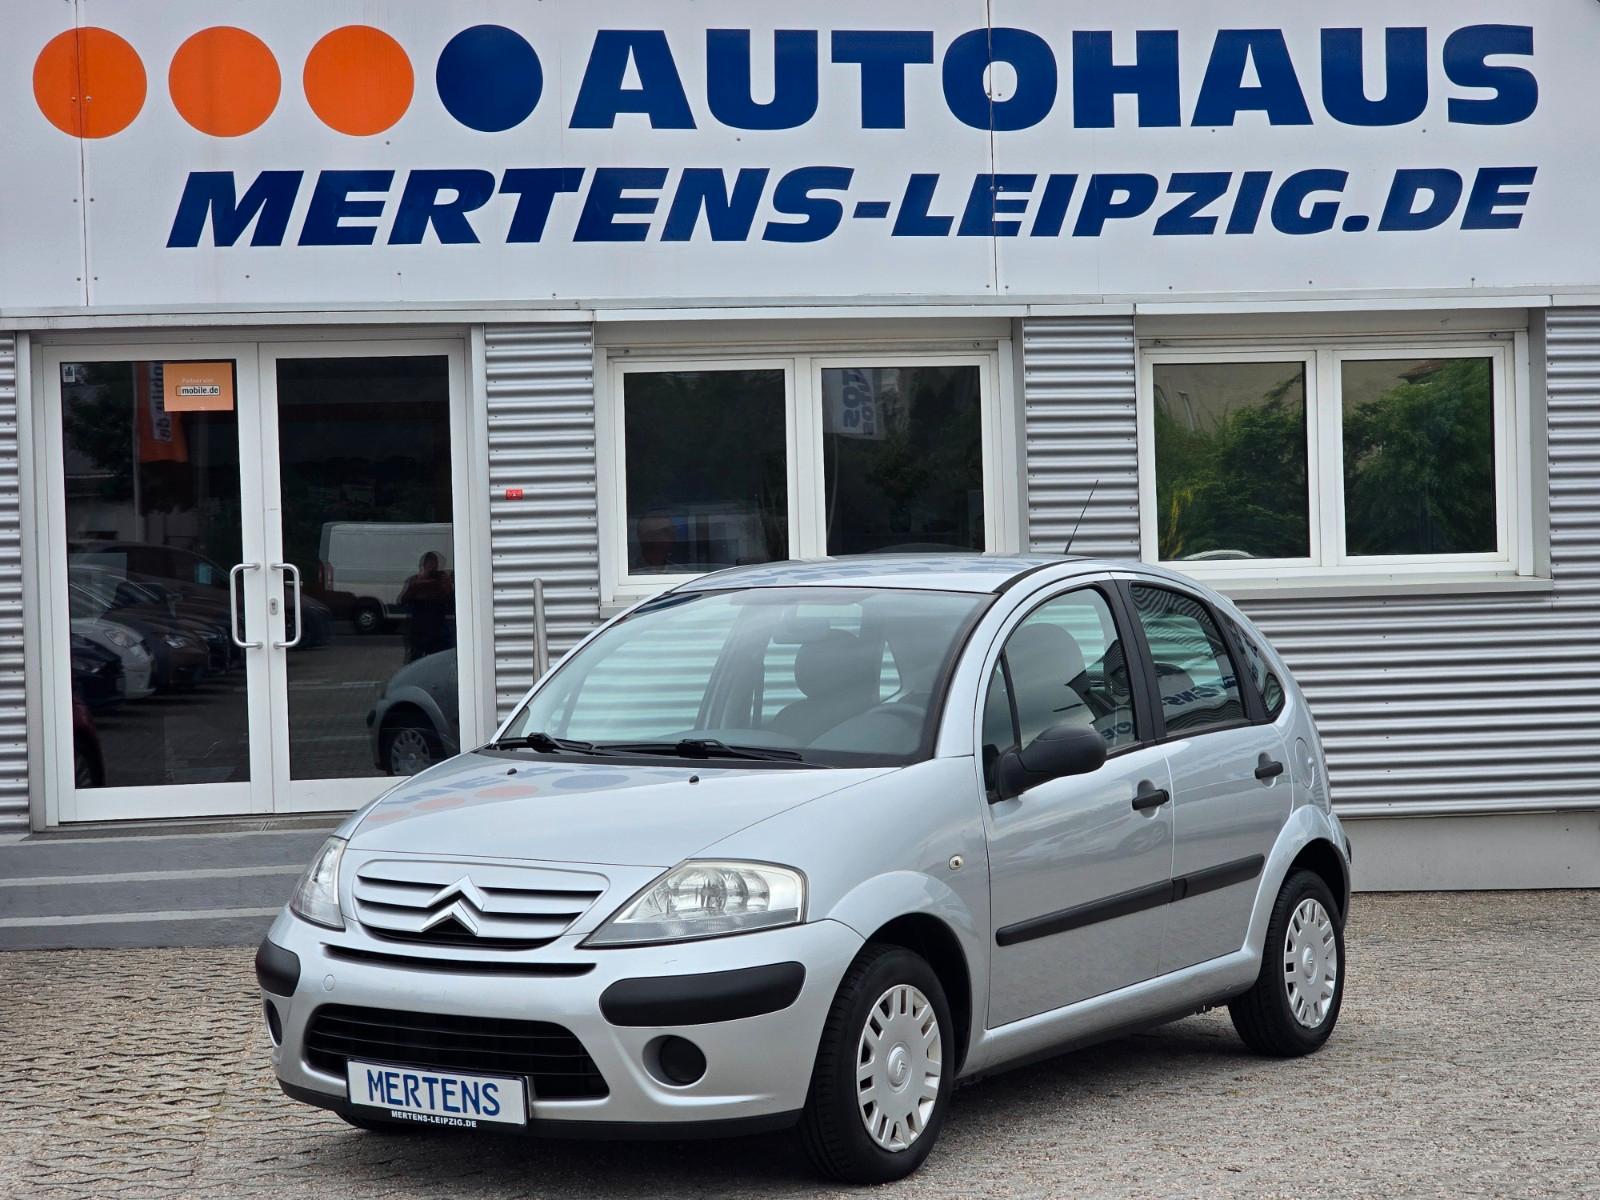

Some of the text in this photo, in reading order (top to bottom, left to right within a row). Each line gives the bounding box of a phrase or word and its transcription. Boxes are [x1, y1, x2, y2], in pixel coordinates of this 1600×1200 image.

[570, 24, 1538, 132] AUTOHAUS
[167, 166, 1537, 248] MERTENS-LEIPZIG.DE
[182, 386, 218, 394] mobile.de
[367, 1069, 500, 1116] MERTENS
[391, 1110, 477, 1128] MERTENS-LEIPZIG.DE
